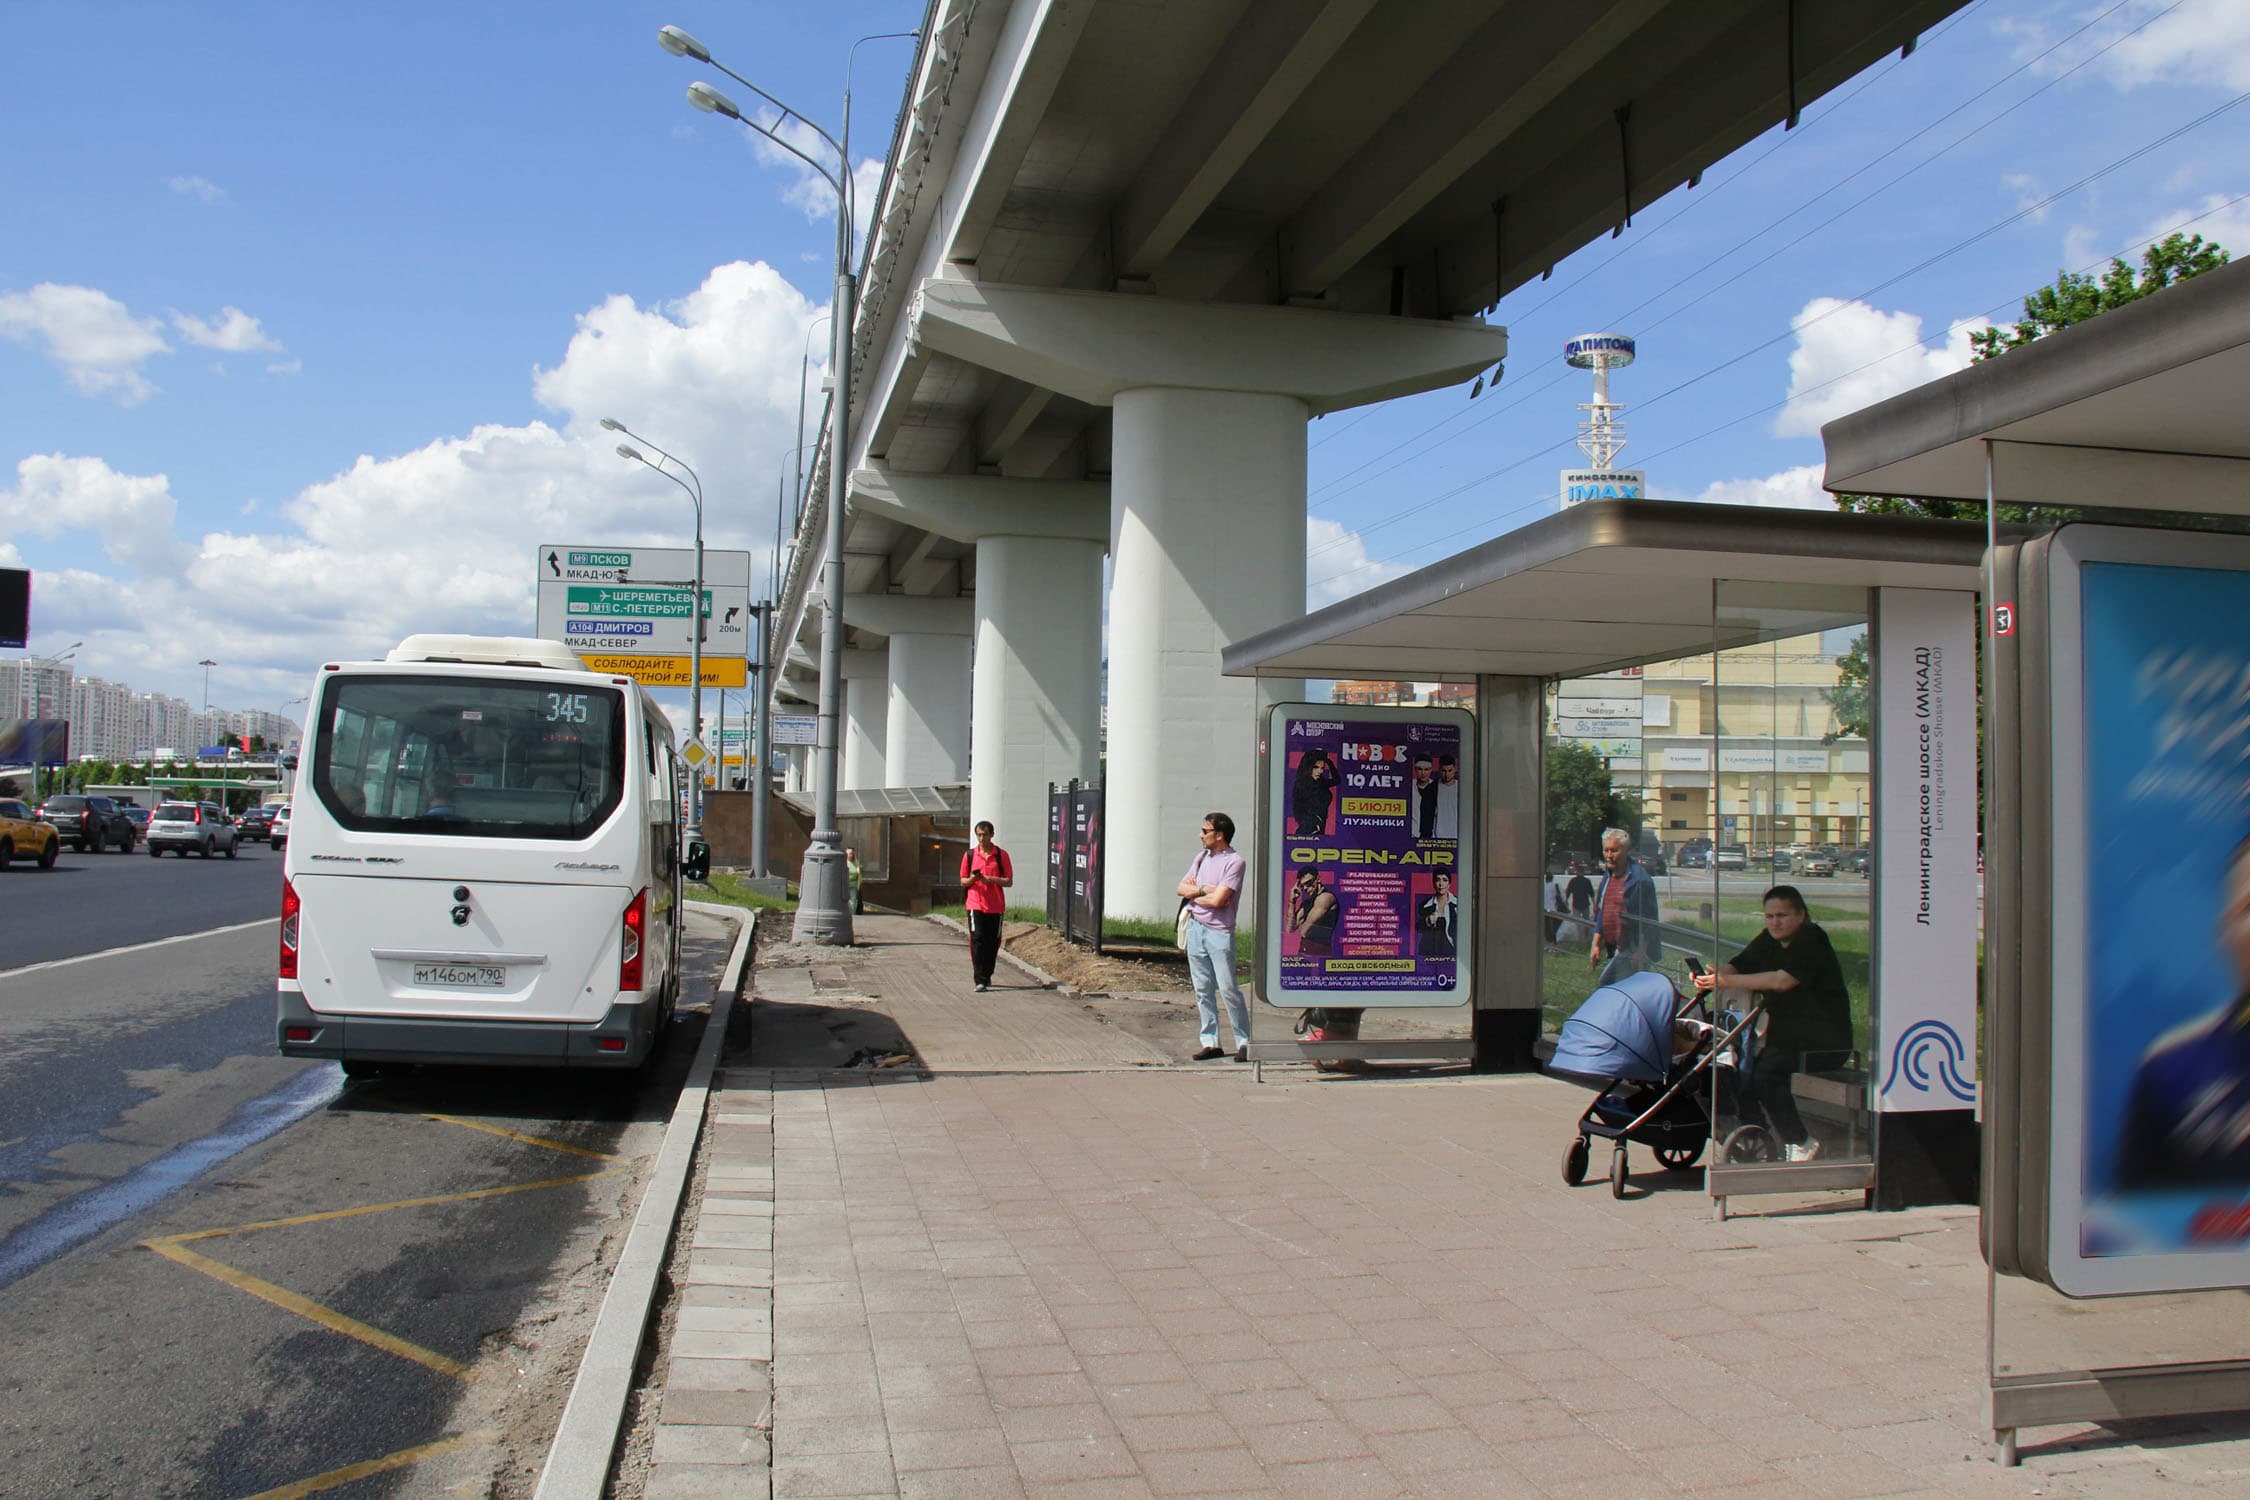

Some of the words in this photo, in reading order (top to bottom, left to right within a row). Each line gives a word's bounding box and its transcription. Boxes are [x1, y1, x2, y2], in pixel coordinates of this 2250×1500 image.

[1567, 474, 1639, 482] КИНОСФЕРА
[1568, 484, 1640, 502] IMAX
[589, 553, 629, 565] ПСКОВ
[612, 602, 691, 615] С.-ПЕТЕРБУРГ
[569, 623, 593, 632] А104
[594, 623, 650, 634] ДМИТРОВ
[719, 625, 741, 633] 200м
[565, 637, 638, 648] МКАД-СЕВЕР
[593, 657, 675, 670] СОБЛЮДАЙТЕ
[1934, 646, 1944, 695] (MKAD)
[674, 672, 720, 683] РЕИМ!
[1915, 646, 1932, 719] (МКАД)
[546, 692, 588, 723] 345
[1919, 723, 1930, 779] шоссе
[1360, 763, 1390, 771] РАДИО
[1369, 775, 1404, 788] ЛЕТ
[1934, 739, 1946, 831] Leningradskoe
[1347, 801, 1356, 811] 5
[1359, 802, 1402, 812] ИЮЛЯ
[1343, 817, 1405, 827] ЛУЖНИКИ
[1290, 847, 1454, 865] OPEN-AIR
[1916, 783, 1933, 926] Ленинградское
[1330, 962, 1355, 970] ВХОД
[1356, 961, 1411, 971] СВОБОДНЫЙ
[417, 967, 477, 984] М146ОМ
[480, 968, 501, 980] 790
[1437, 974, 1456, 986] 0+
